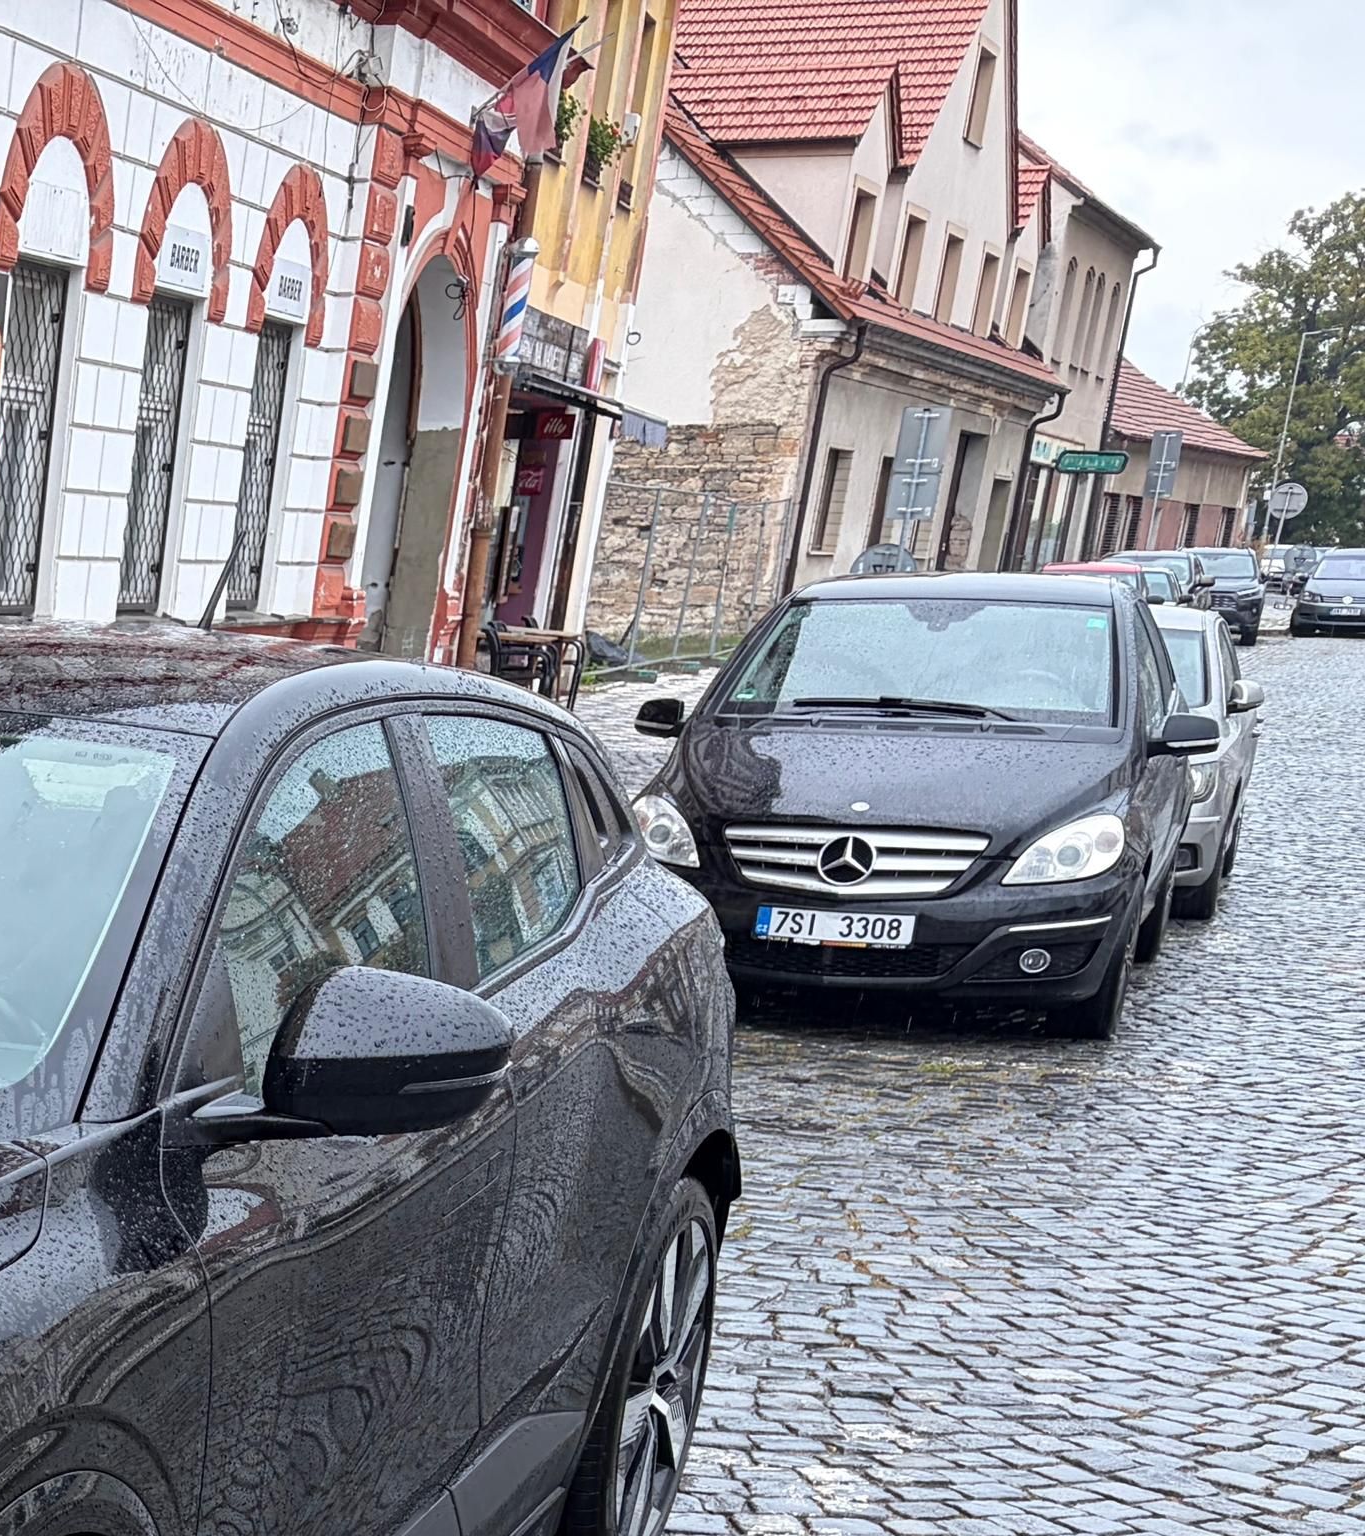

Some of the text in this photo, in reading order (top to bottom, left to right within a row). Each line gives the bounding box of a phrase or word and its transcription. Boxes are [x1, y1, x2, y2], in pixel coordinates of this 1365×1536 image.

[170, 243, 200, 274] BARBER
[278, 275, 303, 302] BARBER
[544, 417, 567, 437] illy
[774, 911, 902, 940] 7SI 3308
